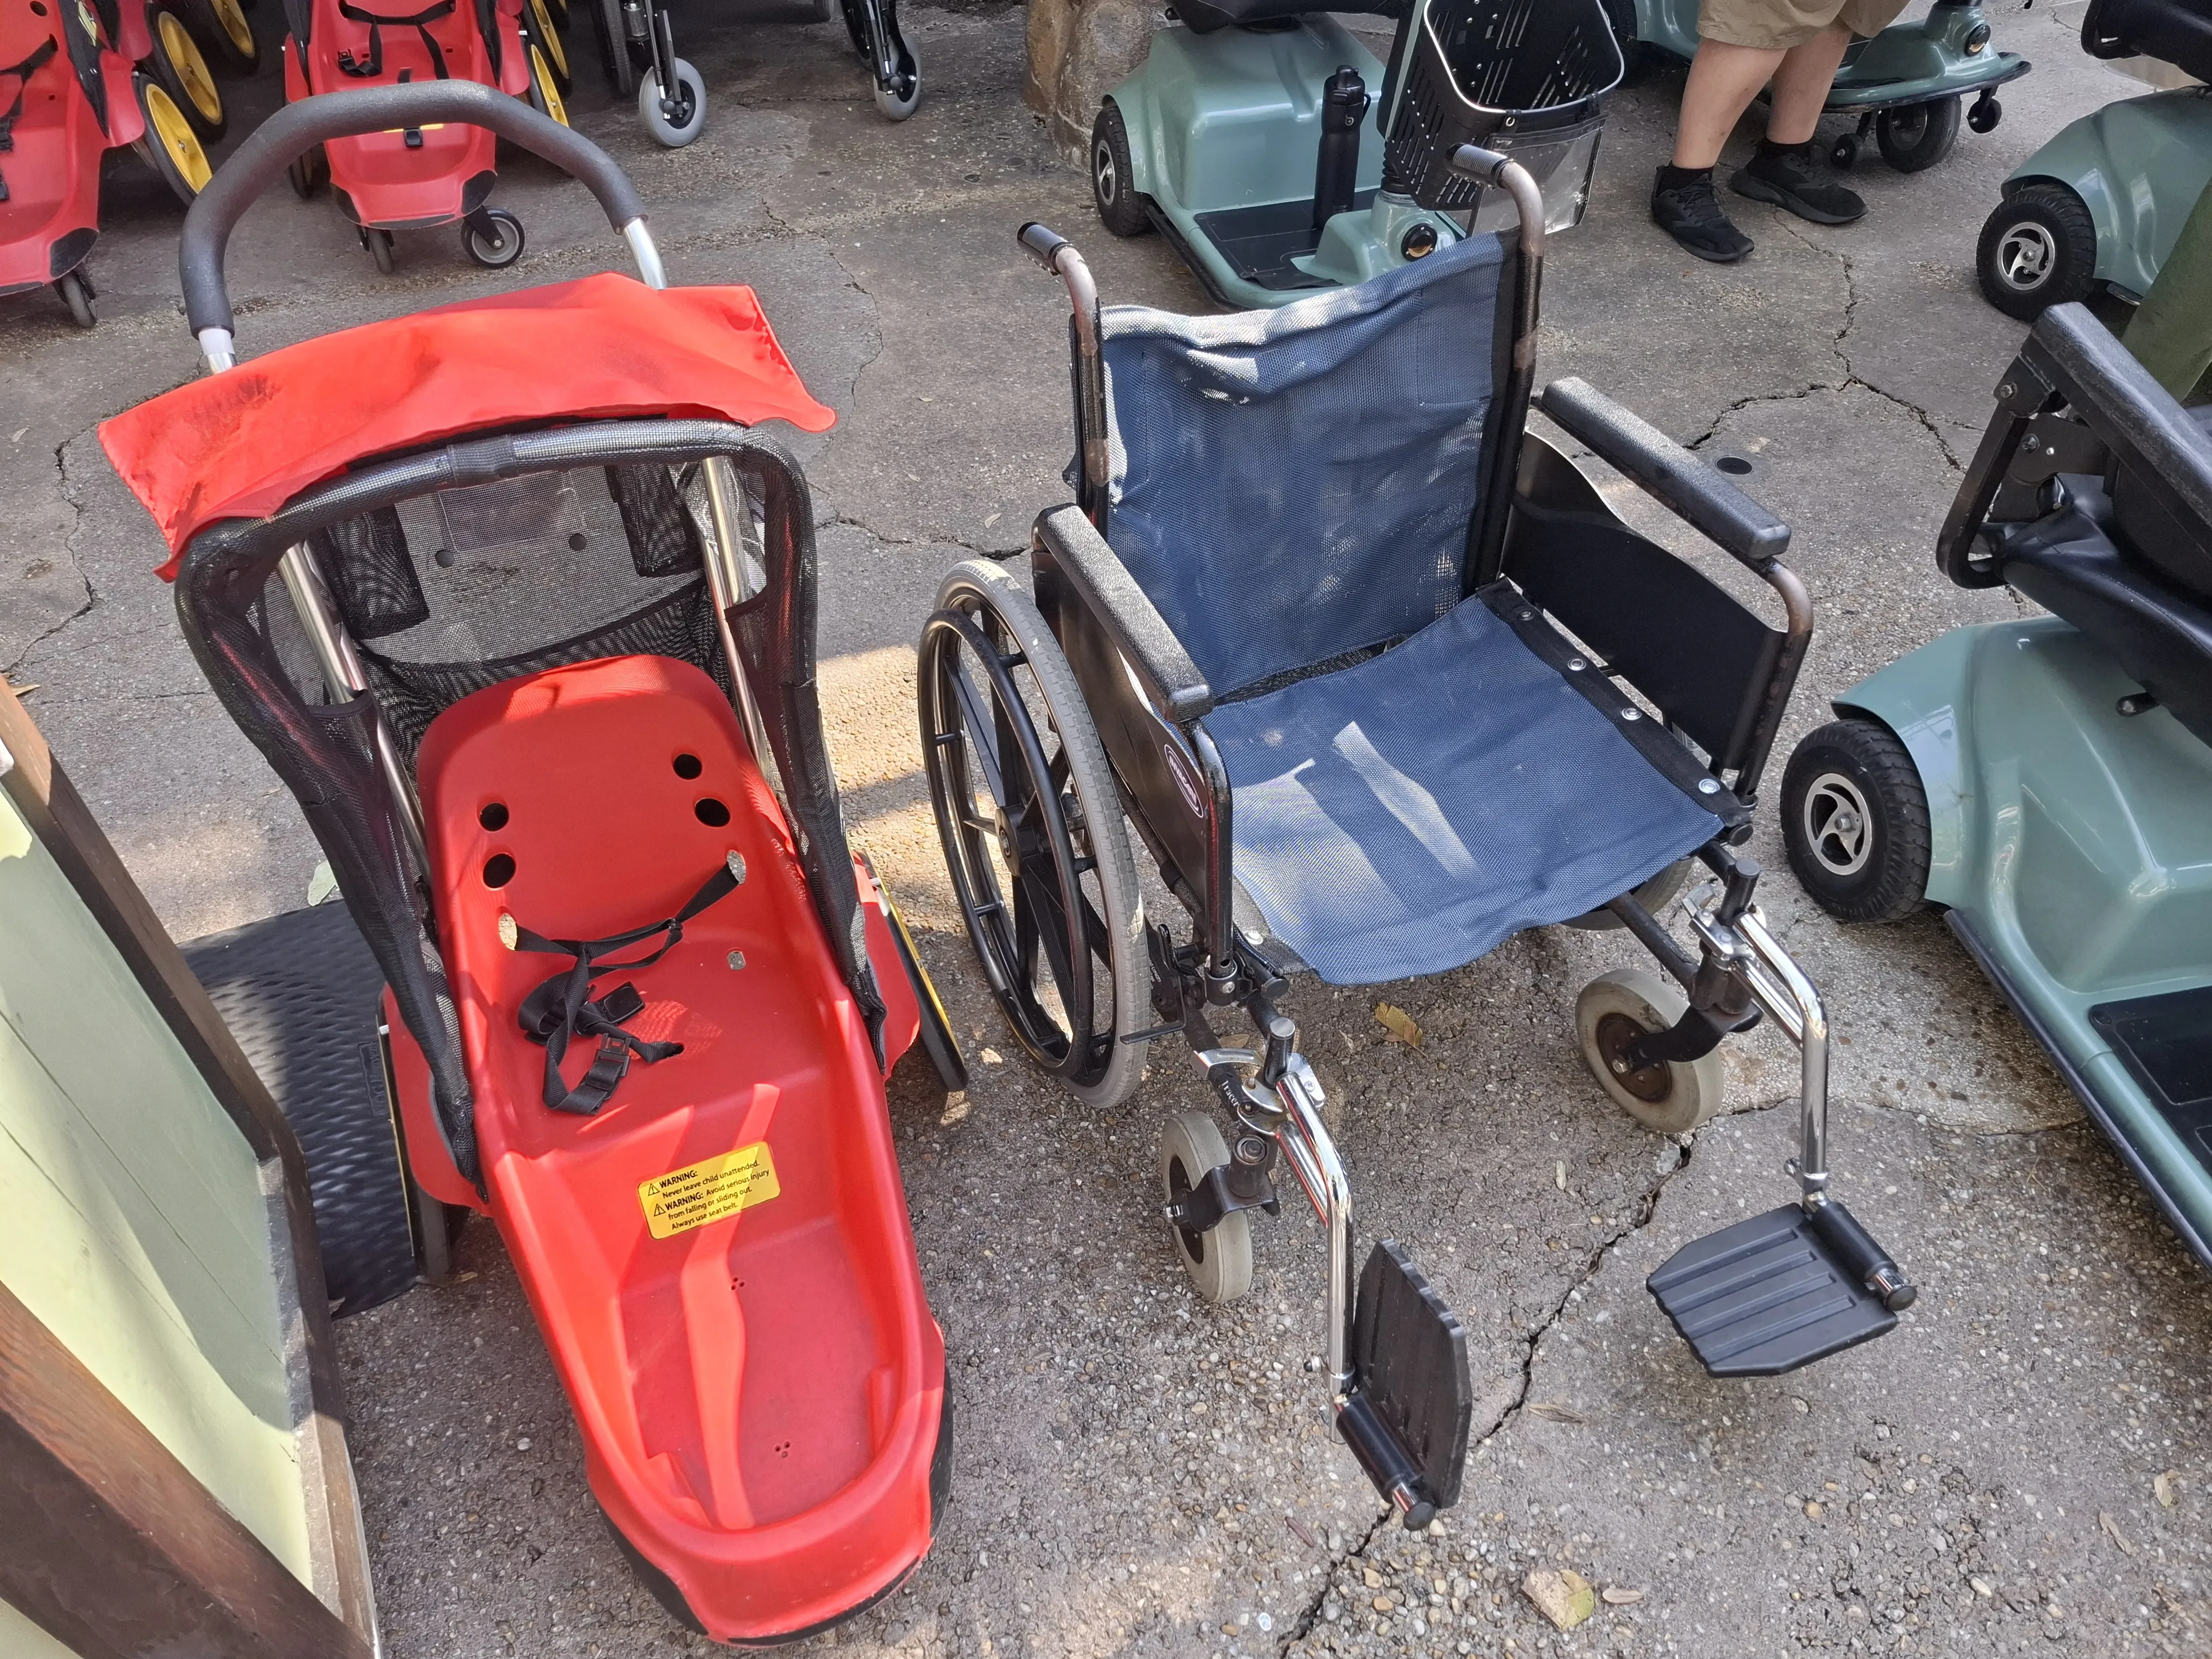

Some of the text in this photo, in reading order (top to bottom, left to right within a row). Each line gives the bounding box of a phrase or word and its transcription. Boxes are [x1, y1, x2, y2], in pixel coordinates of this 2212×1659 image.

[1169, 755, 1198, 806] INVACARE
[1221, 1079, 1240, 1107] Tracer
[659, 1169, 698, 1188] WARNING:
[663, 1160, 760, 1199] Never leave child unattended.
[665, 1169, 769, 1211] WARNING: Avoid serious injury
[668, 1211, 685, 1220] from
[686, 1203, 707, 1216] falling
[716, 1192, 738, 1204] sliding
[739, 1186, 753, 1195] out.
[672, 1202, 738, 1230] Always use seat belt.
